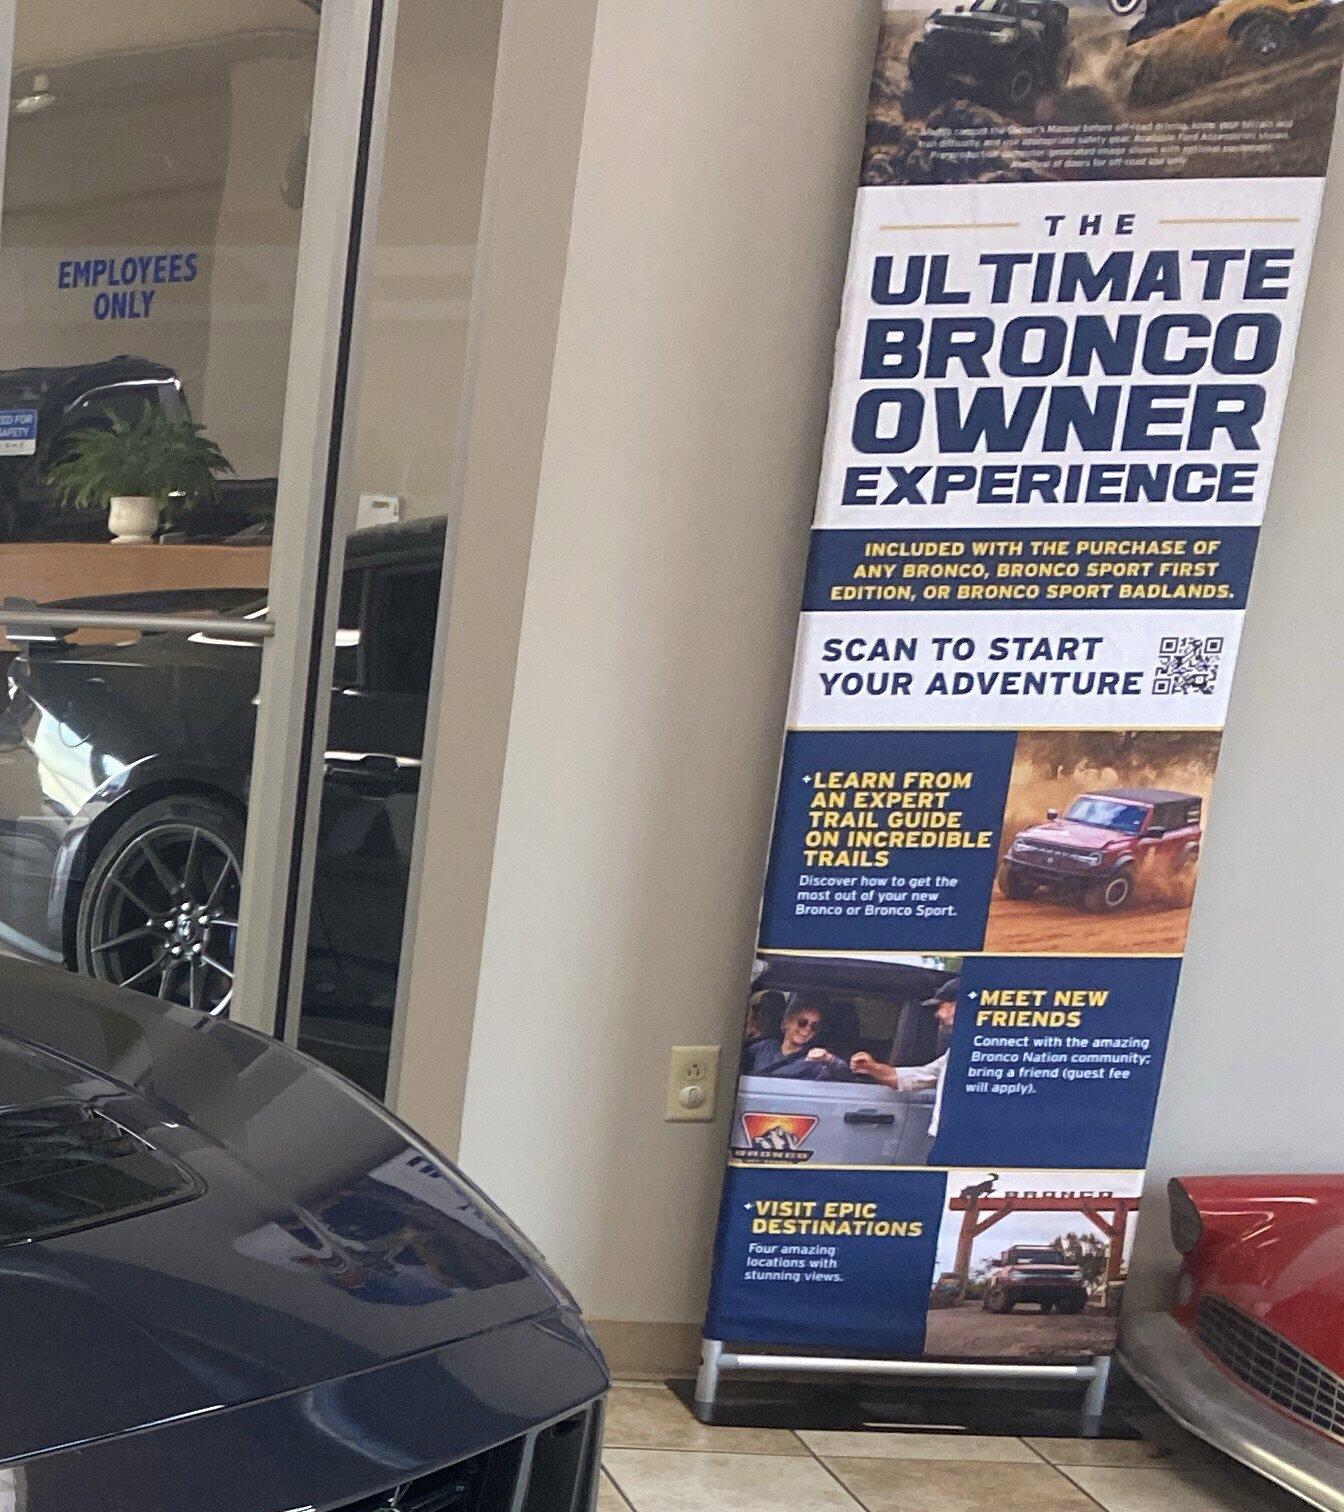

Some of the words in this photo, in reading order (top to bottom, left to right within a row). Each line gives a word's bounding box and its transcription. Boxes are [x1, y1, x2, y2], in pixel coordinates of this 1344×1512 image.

[1043, 214, 1137, 236] THE
[57, 253, 198, 289] EMPLOYEES
[870, 248, 1295, 306] ULTIMATE
[93, 290, 156, 320] ONLY
[859, 313, 1282, 380] BRONCO
[851, 384, 1267, 454] OWNER
[841, 463, 1259, 506] EXPERIENCE
[865, 541, 965, 557] INCLUDED
[971, 541, 1023, 556] WITH
[1031, 541, 1070, 555] THE
[1076, 540, 1187, 555] PURCHASE
[1193, 540, 1221, 555] OF
[853, 564, 897, 578] ANY
[902, 563, 990, 579] BRONCO,
[996, 563, 1080, 578] BRONCO
[1085, 562, 1154, 577] SPORT
[1159, 562, 1220, 577] FIRST
[830, 586, 917, 601] EDITION,
[922, 585, 951, 600] OR
[956, 585, 1040, 600] BRONCO
[1045, 584, 1113, 599] SPORT
[1118, 584, 1235, 599] BADLANDS.
[822, 637, 918, 661] SCAN
[931, 637, 975, 661] TO
[988, 637, 1104, 661] START
[819, 672, 913, 696] YOUR
[925, 671, 1144, 696] ADVENTURE
[813, 771, 896, 789] LEARN
[903, 772, 973, 789] FROM
[810, 791, 847, 808] AN
[853, 791, 950, 809] EXPERT
[809, 811, 879, 828] TRAIL
[887, 811, 963, 829] GUIDE
[805, 830, 840, 847] ON
[847, 831, 993, 849] INCREDIBLE
[803, 850, 890, 867] TRAILS
[799, 875, 858, 887] Discover
[861, 875, 888, 887] how
[892, 876, 906, 887] to
[908, 876, 932, 890] get
[935, 875, 958, 888] the
[797, 890, 830, 901] most
[834, 890, 857, 901] out
[861, 890, 874, 901] of
[878, 891, 908, 904] your
[911, 891, 939, 901] new
[795, 904, 843, 916] Bronco
[846, 906, 861, 916] or
[864, 905, 912, 917] Bronco
[915, 905, 958, 918] Sport.
[979, 990, 1048, 1007] MEET
[1053, 990, 1110, 1007] NEW
[976, 1010, 1082, 1028] FRIENDS
[973, 1036, 1029, 1048] Connect
[1033, 1036, 1062, 1048] with
[1066, 1037, 1089, 1048] the
[1092, 1037, 1150, 1050] amazing
[971, 1051, 1019, 1063] Bronco
[1022, 1052, 1067, 1063] Nation
[968, 1067, 1003, 1080] bring
[1006, 1069, 1015, 1078] a
[1018, 1067, 1060, 1079] friend
[1062, 1067, 1105, 1081] (guest
[1108, 1068, 1130, 1079] fee
[965, 1082, 988, 1093] will
[991, 1082, 1036, 1095] apply).
[755, 1201, 817, 1217] VISIT
[823, 1202, 878, 1218] EPIC
[752, 1218, 924, 1237] DESTINATIONS
[748, 1243, 779, 1254] Four
[781, 1244, 836, 1257] amazing
[746, 1257, 806, 1268] locations
[809, 1258, 837, 1268] with
[744, 1271, 801, 1283] stunning
[805, 1271, 844, 1282] views.
